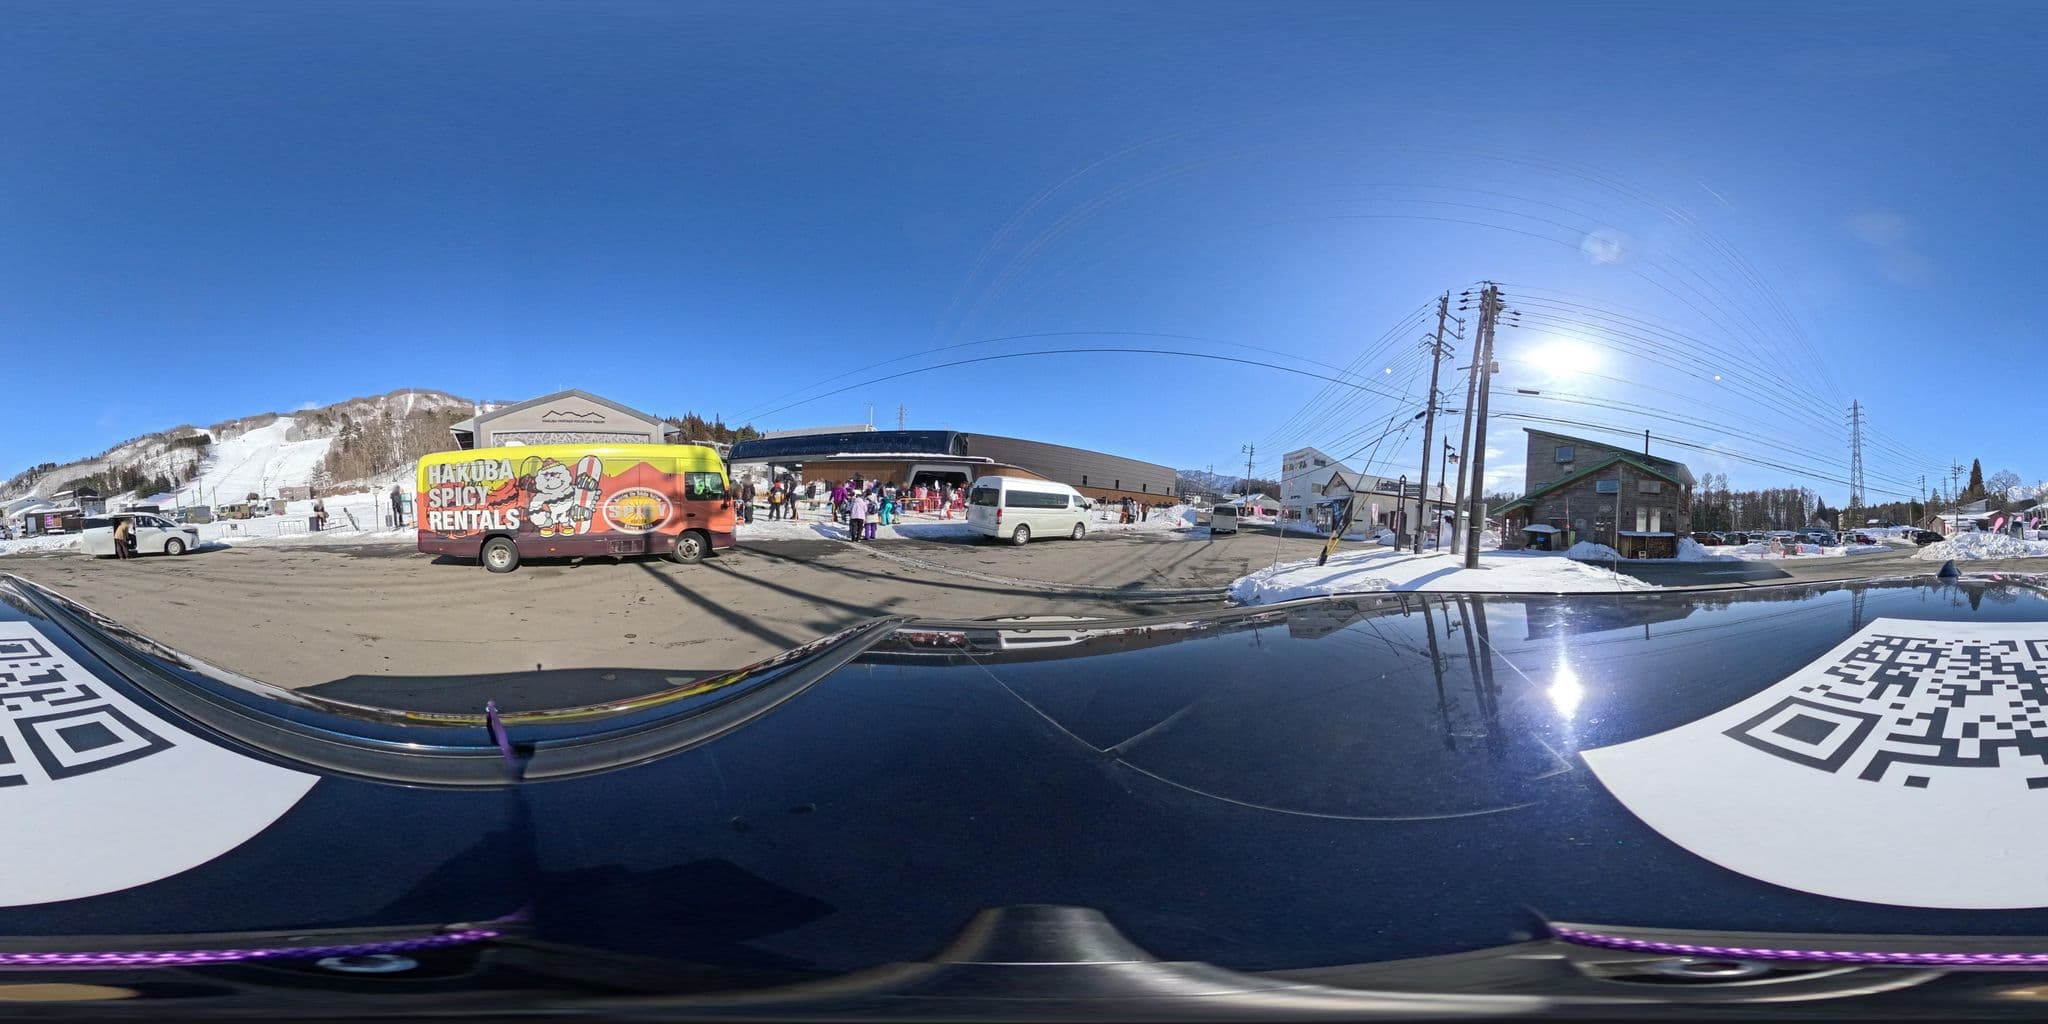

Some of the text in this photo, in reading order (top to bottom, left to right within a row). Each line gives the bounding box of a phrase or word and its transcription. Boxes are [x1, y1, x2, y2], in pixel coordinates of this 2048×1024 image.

[428, 458, 515, 484] HAKUBA
[429, 486, 489, 508] SPICY
[429, 509, 521, 530] RENTALS
